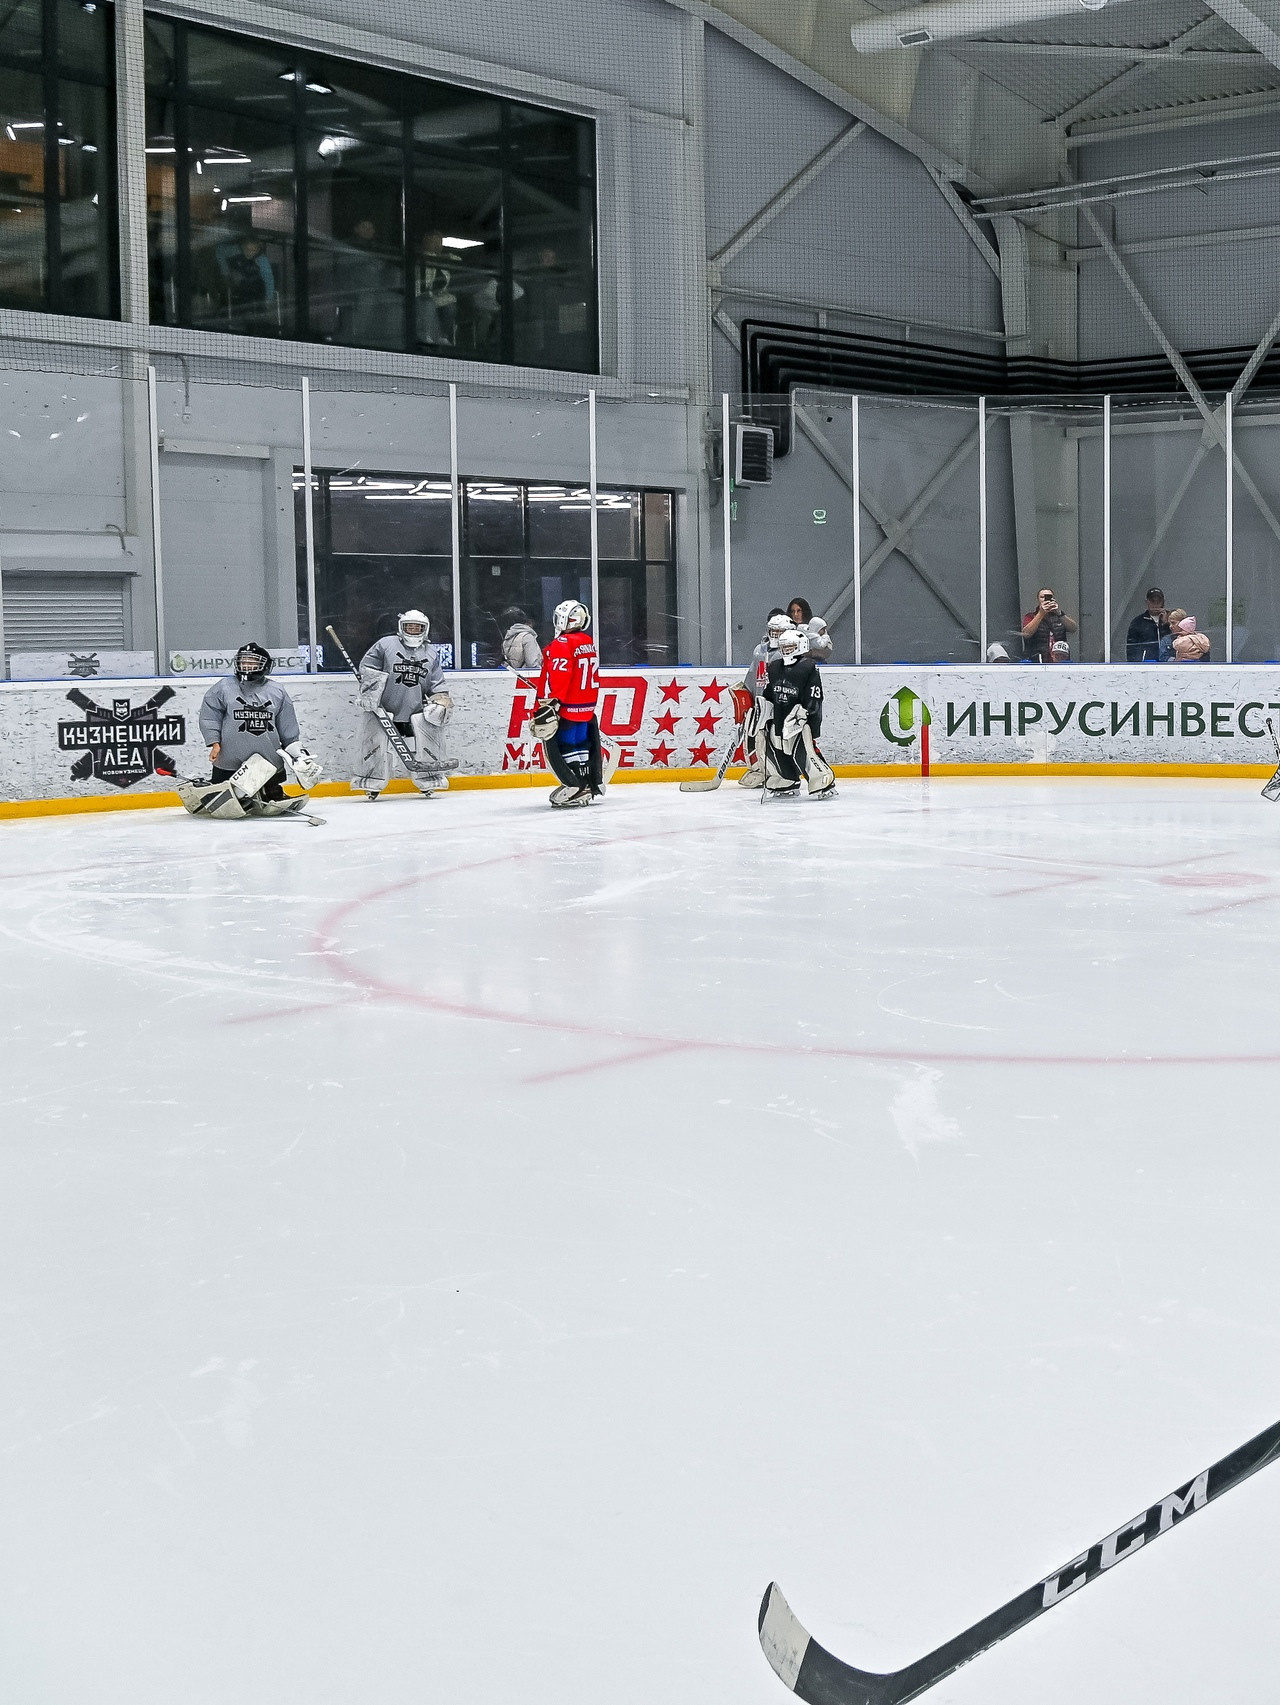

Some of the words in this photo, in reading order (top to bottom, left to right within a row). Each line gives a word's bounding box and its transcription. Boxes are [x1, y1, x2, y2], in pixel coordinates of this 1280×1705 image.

[552, 658, 568, 672] 72
[578, 656, 600, 690] 72
[810, 685, 821, 698] 13
[63, 718, 181, 746] КУЗНЕЦКИЙ
[104, 744, 143, 766] ЛЁД
[1042, 1468, 1209, 1608] CCM
